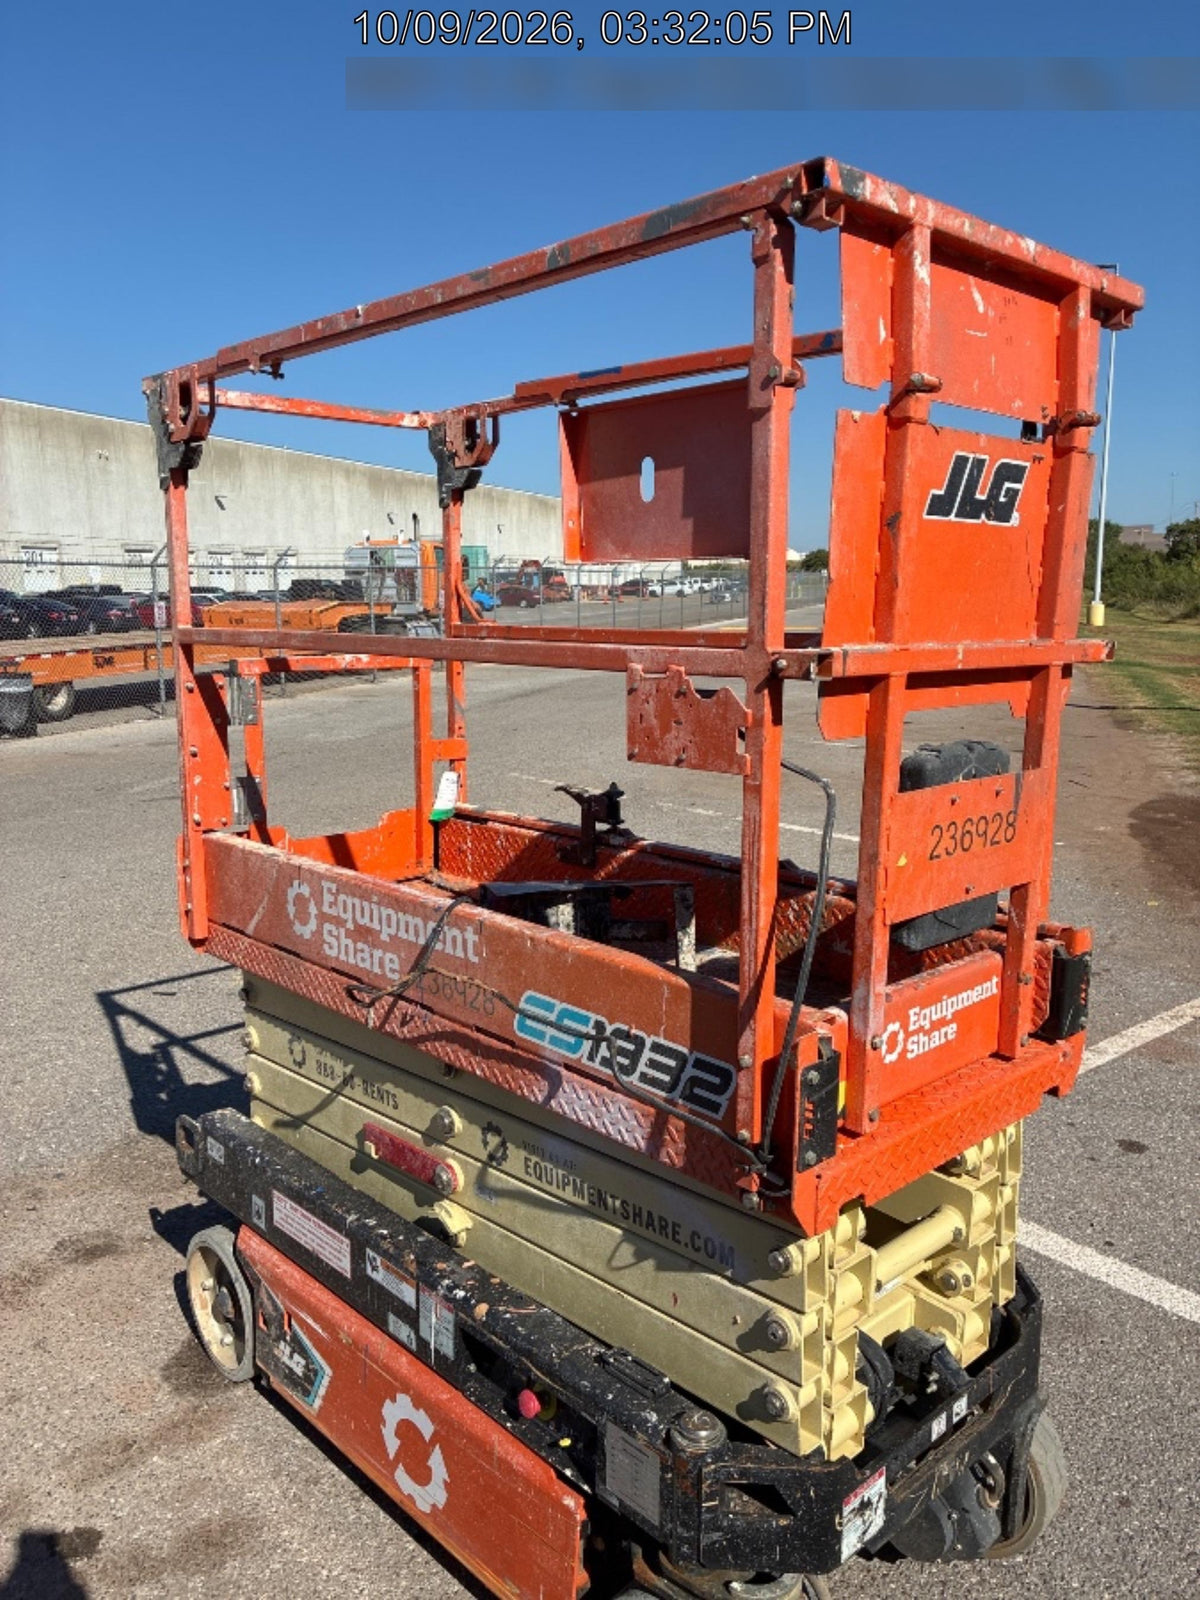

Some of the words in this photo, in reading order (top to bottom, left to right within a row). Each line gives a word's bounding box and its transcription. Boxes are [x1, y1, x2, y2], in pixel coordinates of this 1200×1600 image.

[924, 451, 1029, 526] JLG
[929, 810, 1016, 861] 236928
[321, 880, 480, 963] Equipment
[322, 924, 400, 981] Share
[907, 976, 1000, 1031] Equipment
[906, 1021, 957, 1059] Share
[524, 1157, 736, 1270] EQUIPMENTSHARE.COM
